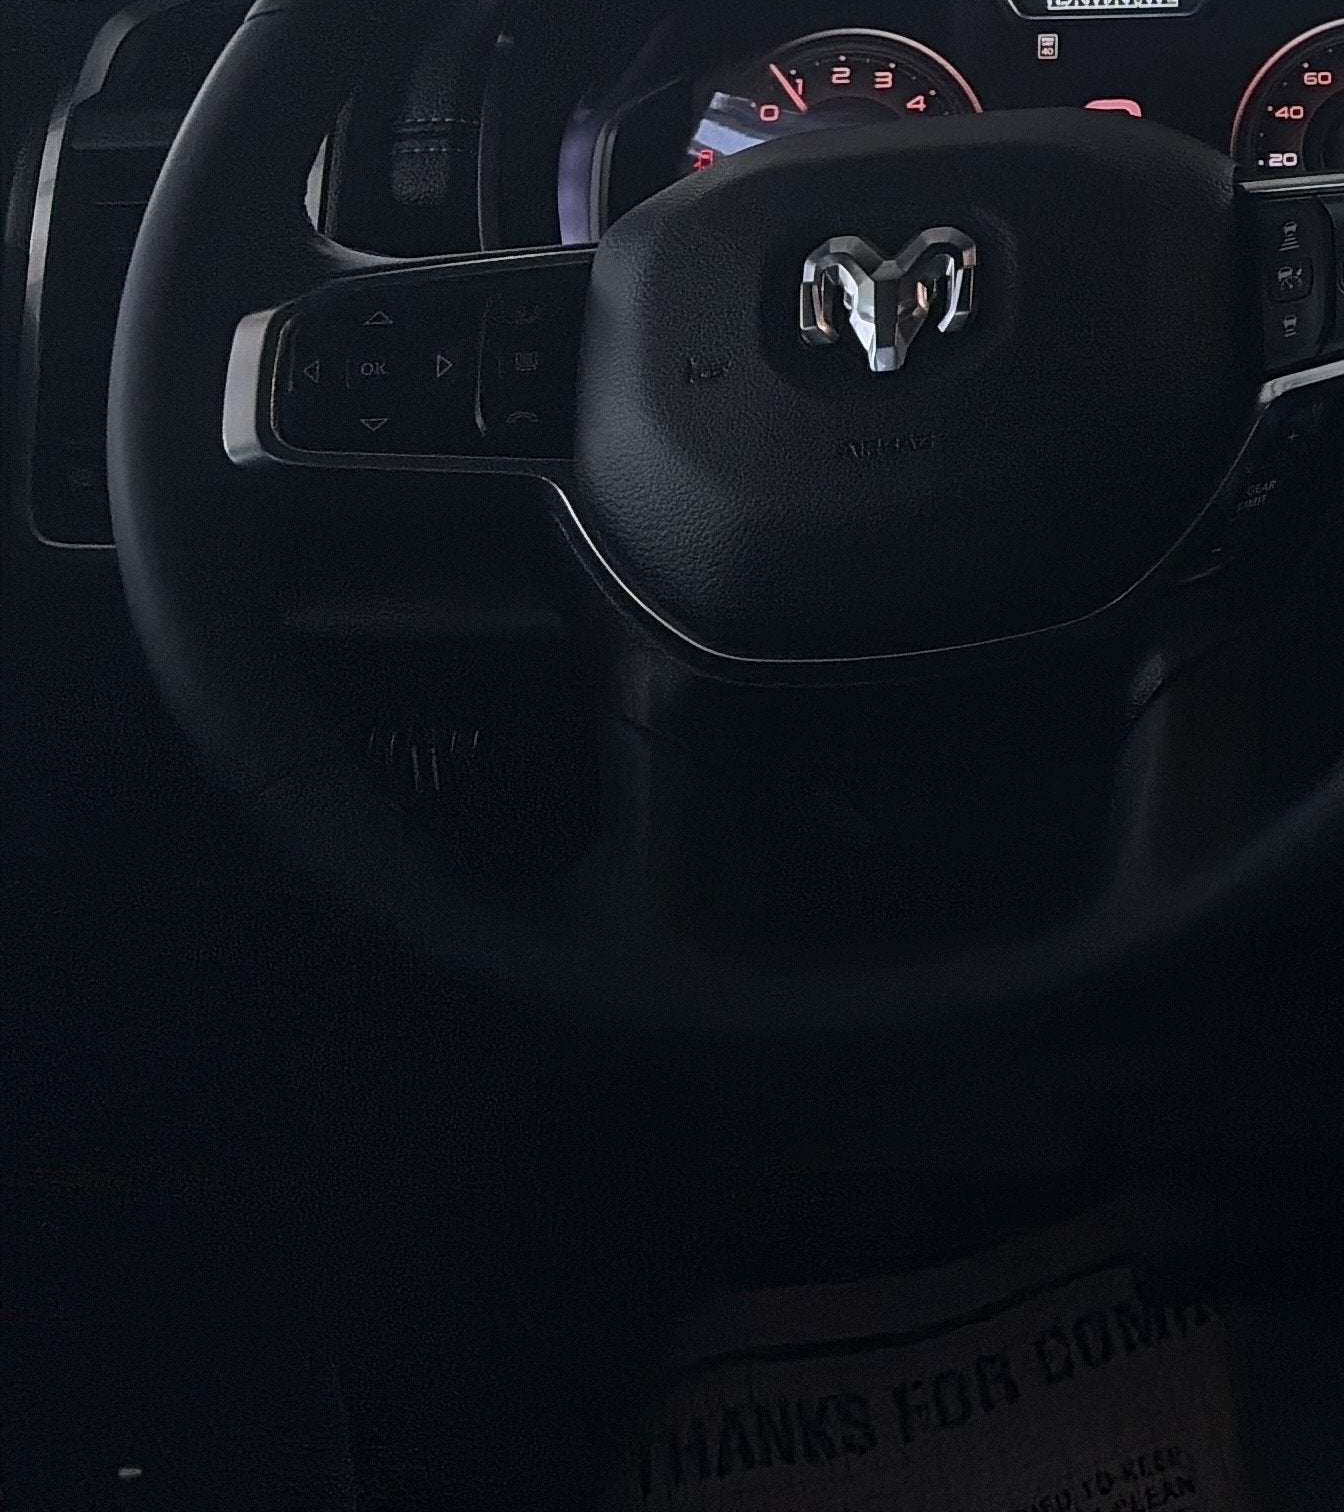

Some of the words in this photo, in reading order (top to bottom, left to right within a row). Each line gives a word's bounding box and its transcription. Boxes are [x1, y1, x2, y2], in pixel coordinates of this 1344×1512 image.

[830, 65, 852, 85] 2
[873, 70, 894, 89] 3
[1303, 70, 1333, 86] 60
[758, 103, 780, 122] 0
[905, 94, 929, 113] 4
[1273, 104, 1305, 120] 40
[1267, 151, 1299, 168] 20
[359, 361, 387, 377] OK
[638, 1392, 879, 1500] THANKS
[886, 1351, 1022, 1445] FOR
